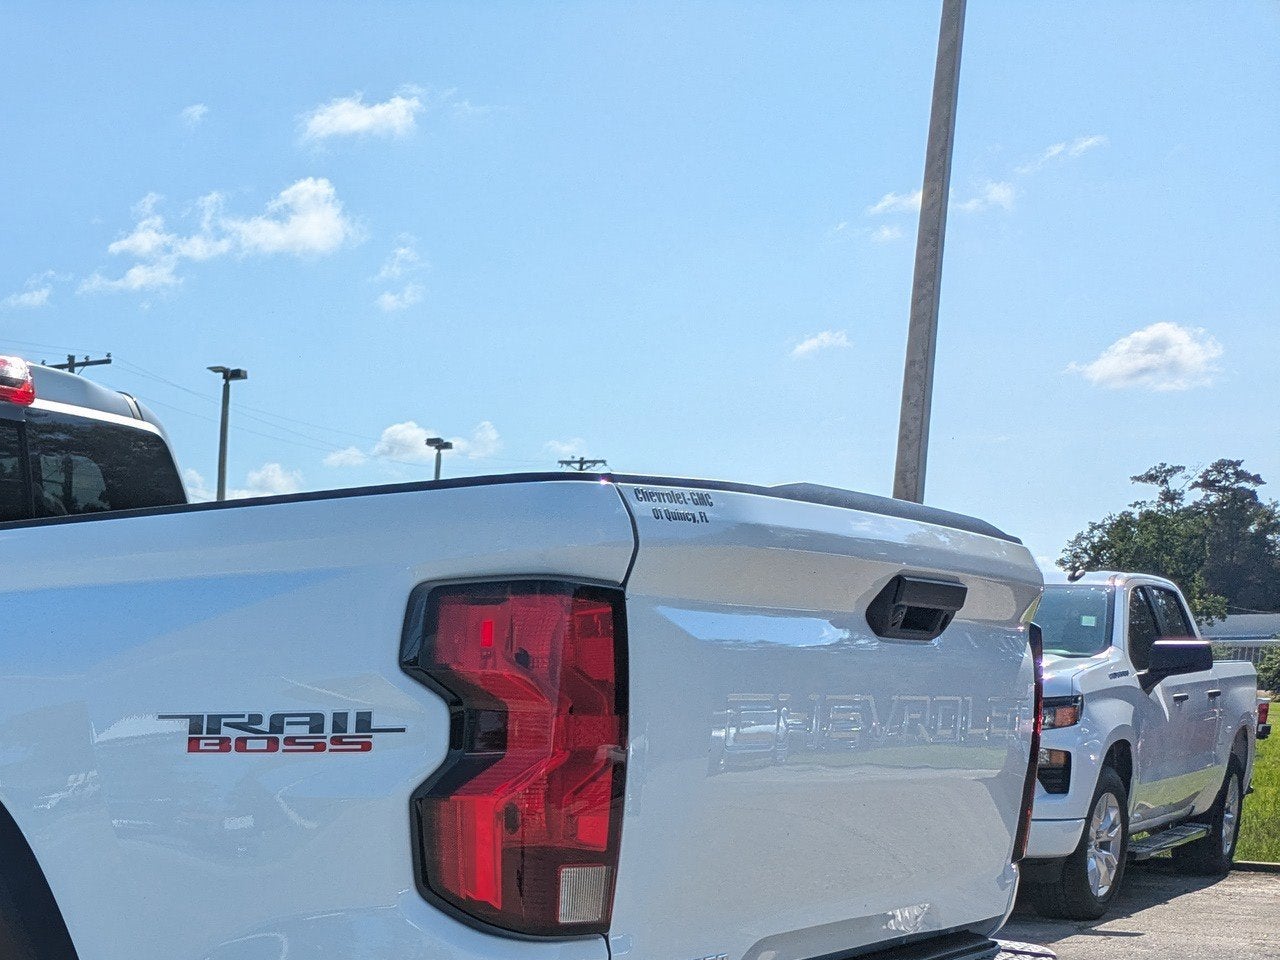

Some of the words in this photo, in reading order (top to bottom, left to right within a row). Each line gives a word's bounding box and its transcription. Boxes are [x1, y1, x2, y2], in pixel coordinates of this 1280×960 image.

[634, 487, 714, 508] Chevrolet-GMC
[664, 508, 699, 524] Quincy,
[699, 511, 710, 524] FL
[157, 711, 406, 736] TRAIL
[187, 735, 373, 753] BOSS
